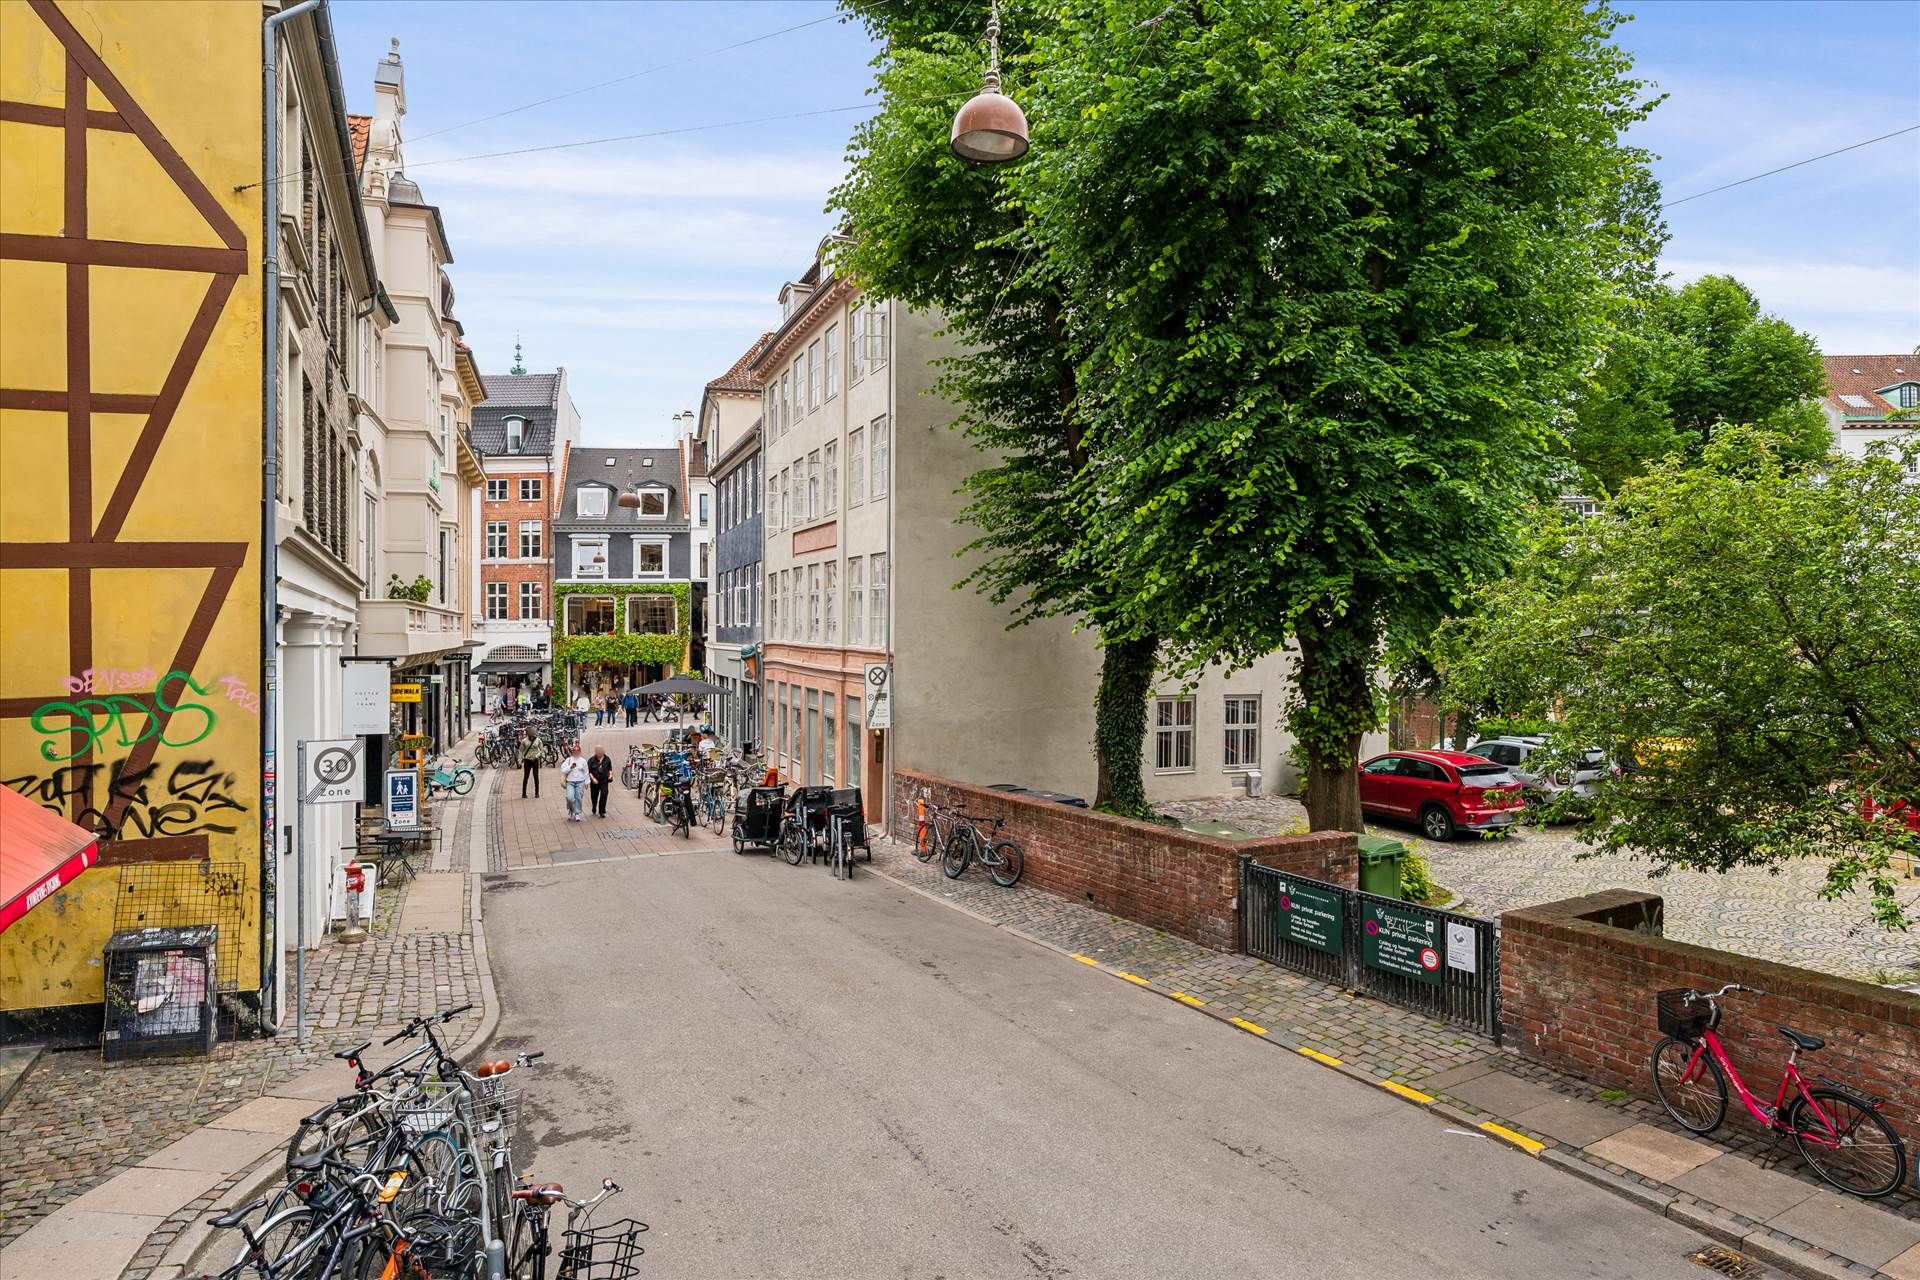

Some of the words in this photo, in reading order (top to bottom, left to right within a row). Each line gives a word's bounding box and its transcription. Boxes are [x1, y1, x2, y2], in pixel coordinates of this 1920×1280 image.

[322, 759, 348, 774] 30
[320, 788, 351, 797] Zone
[1290, 901, 1301, 910] KUN
[1314, 910, 1335, 921] parkering
[1379, 927, 1391, 935] KUN
[1391, 931, 1407, 940] privat
[1407, 936, 1433, 948] parkering
